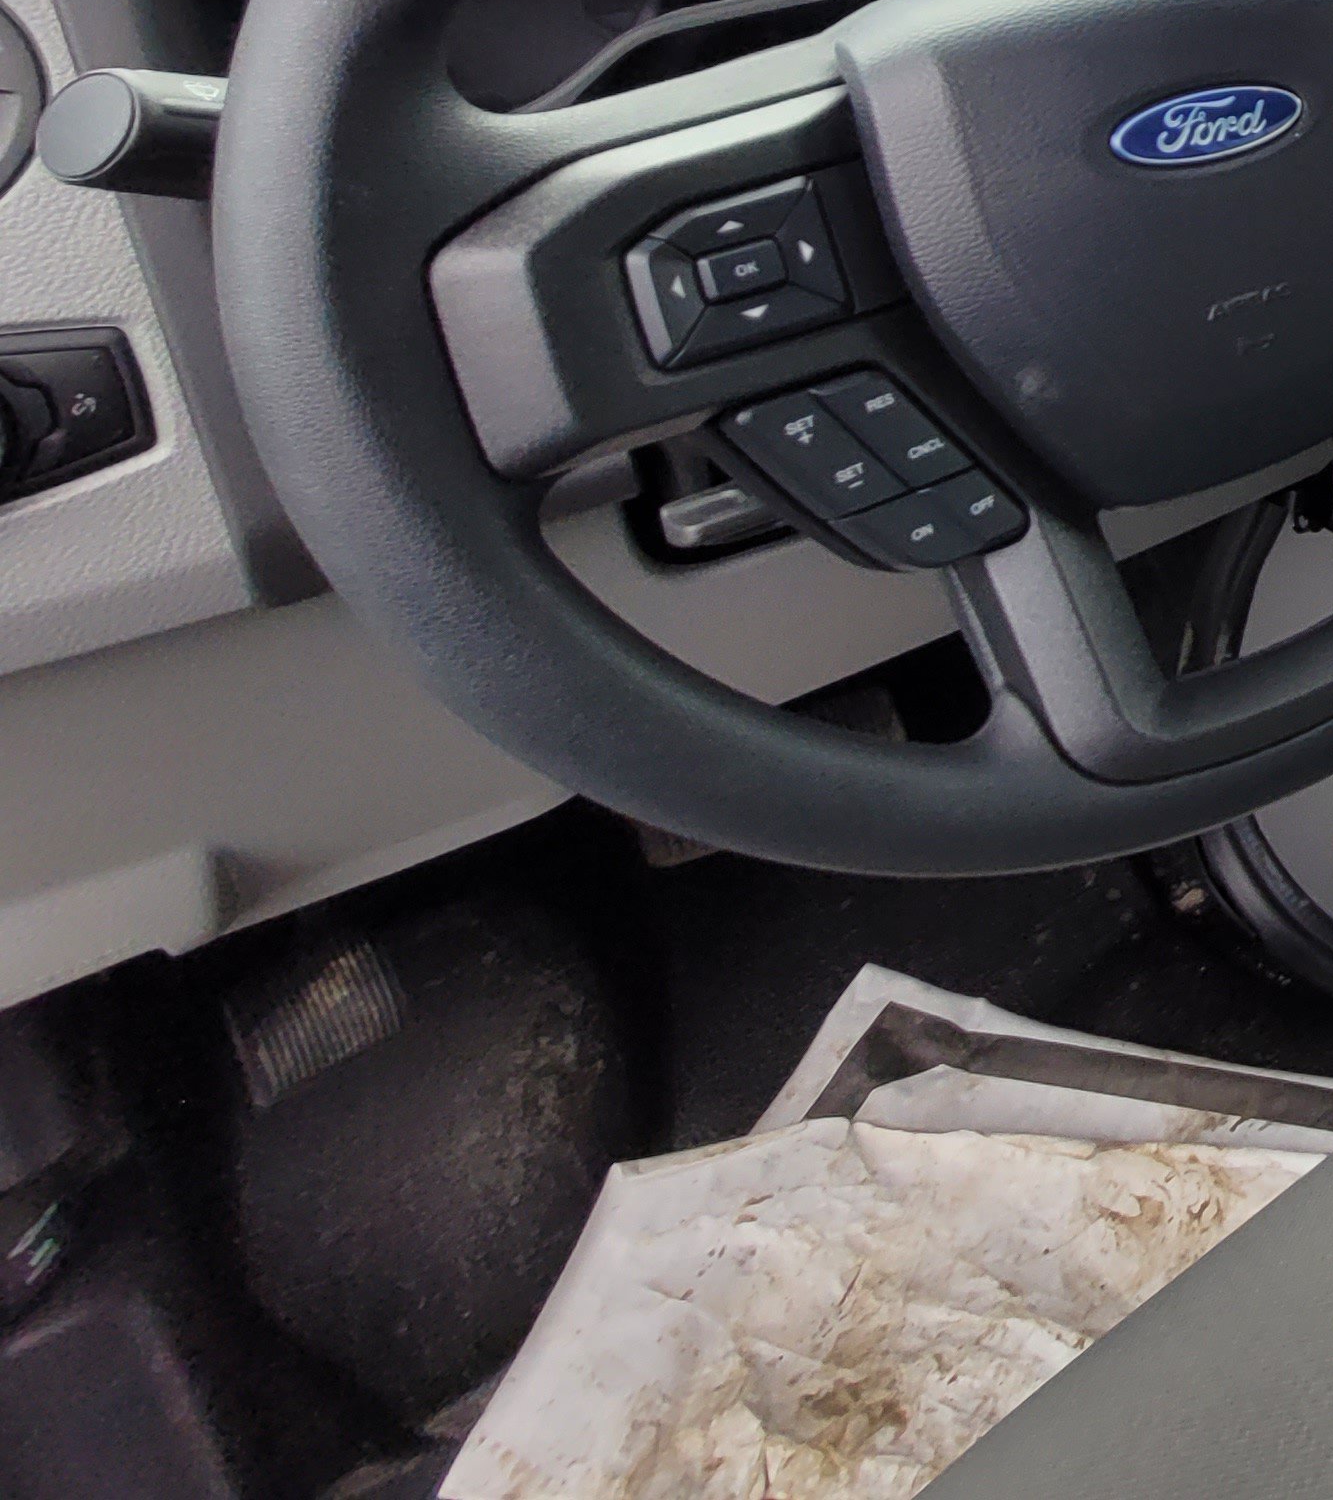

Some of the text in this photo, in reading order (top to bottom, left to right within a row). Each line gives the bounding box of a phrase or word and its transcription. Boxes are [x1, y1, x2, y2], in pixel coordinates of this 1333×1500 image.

[1156, 95, 1268, 154] Ford
[734, 261, 760, 277] OK
[864, 392, 896, 413] RES
[784, 413, 814, 436] SET
[906, 436, 945, 460] CNCL
[834, 461, 864, 484] SET
[969, 494, 996, 516] OFF
[910, 522, 935, 542] ON
